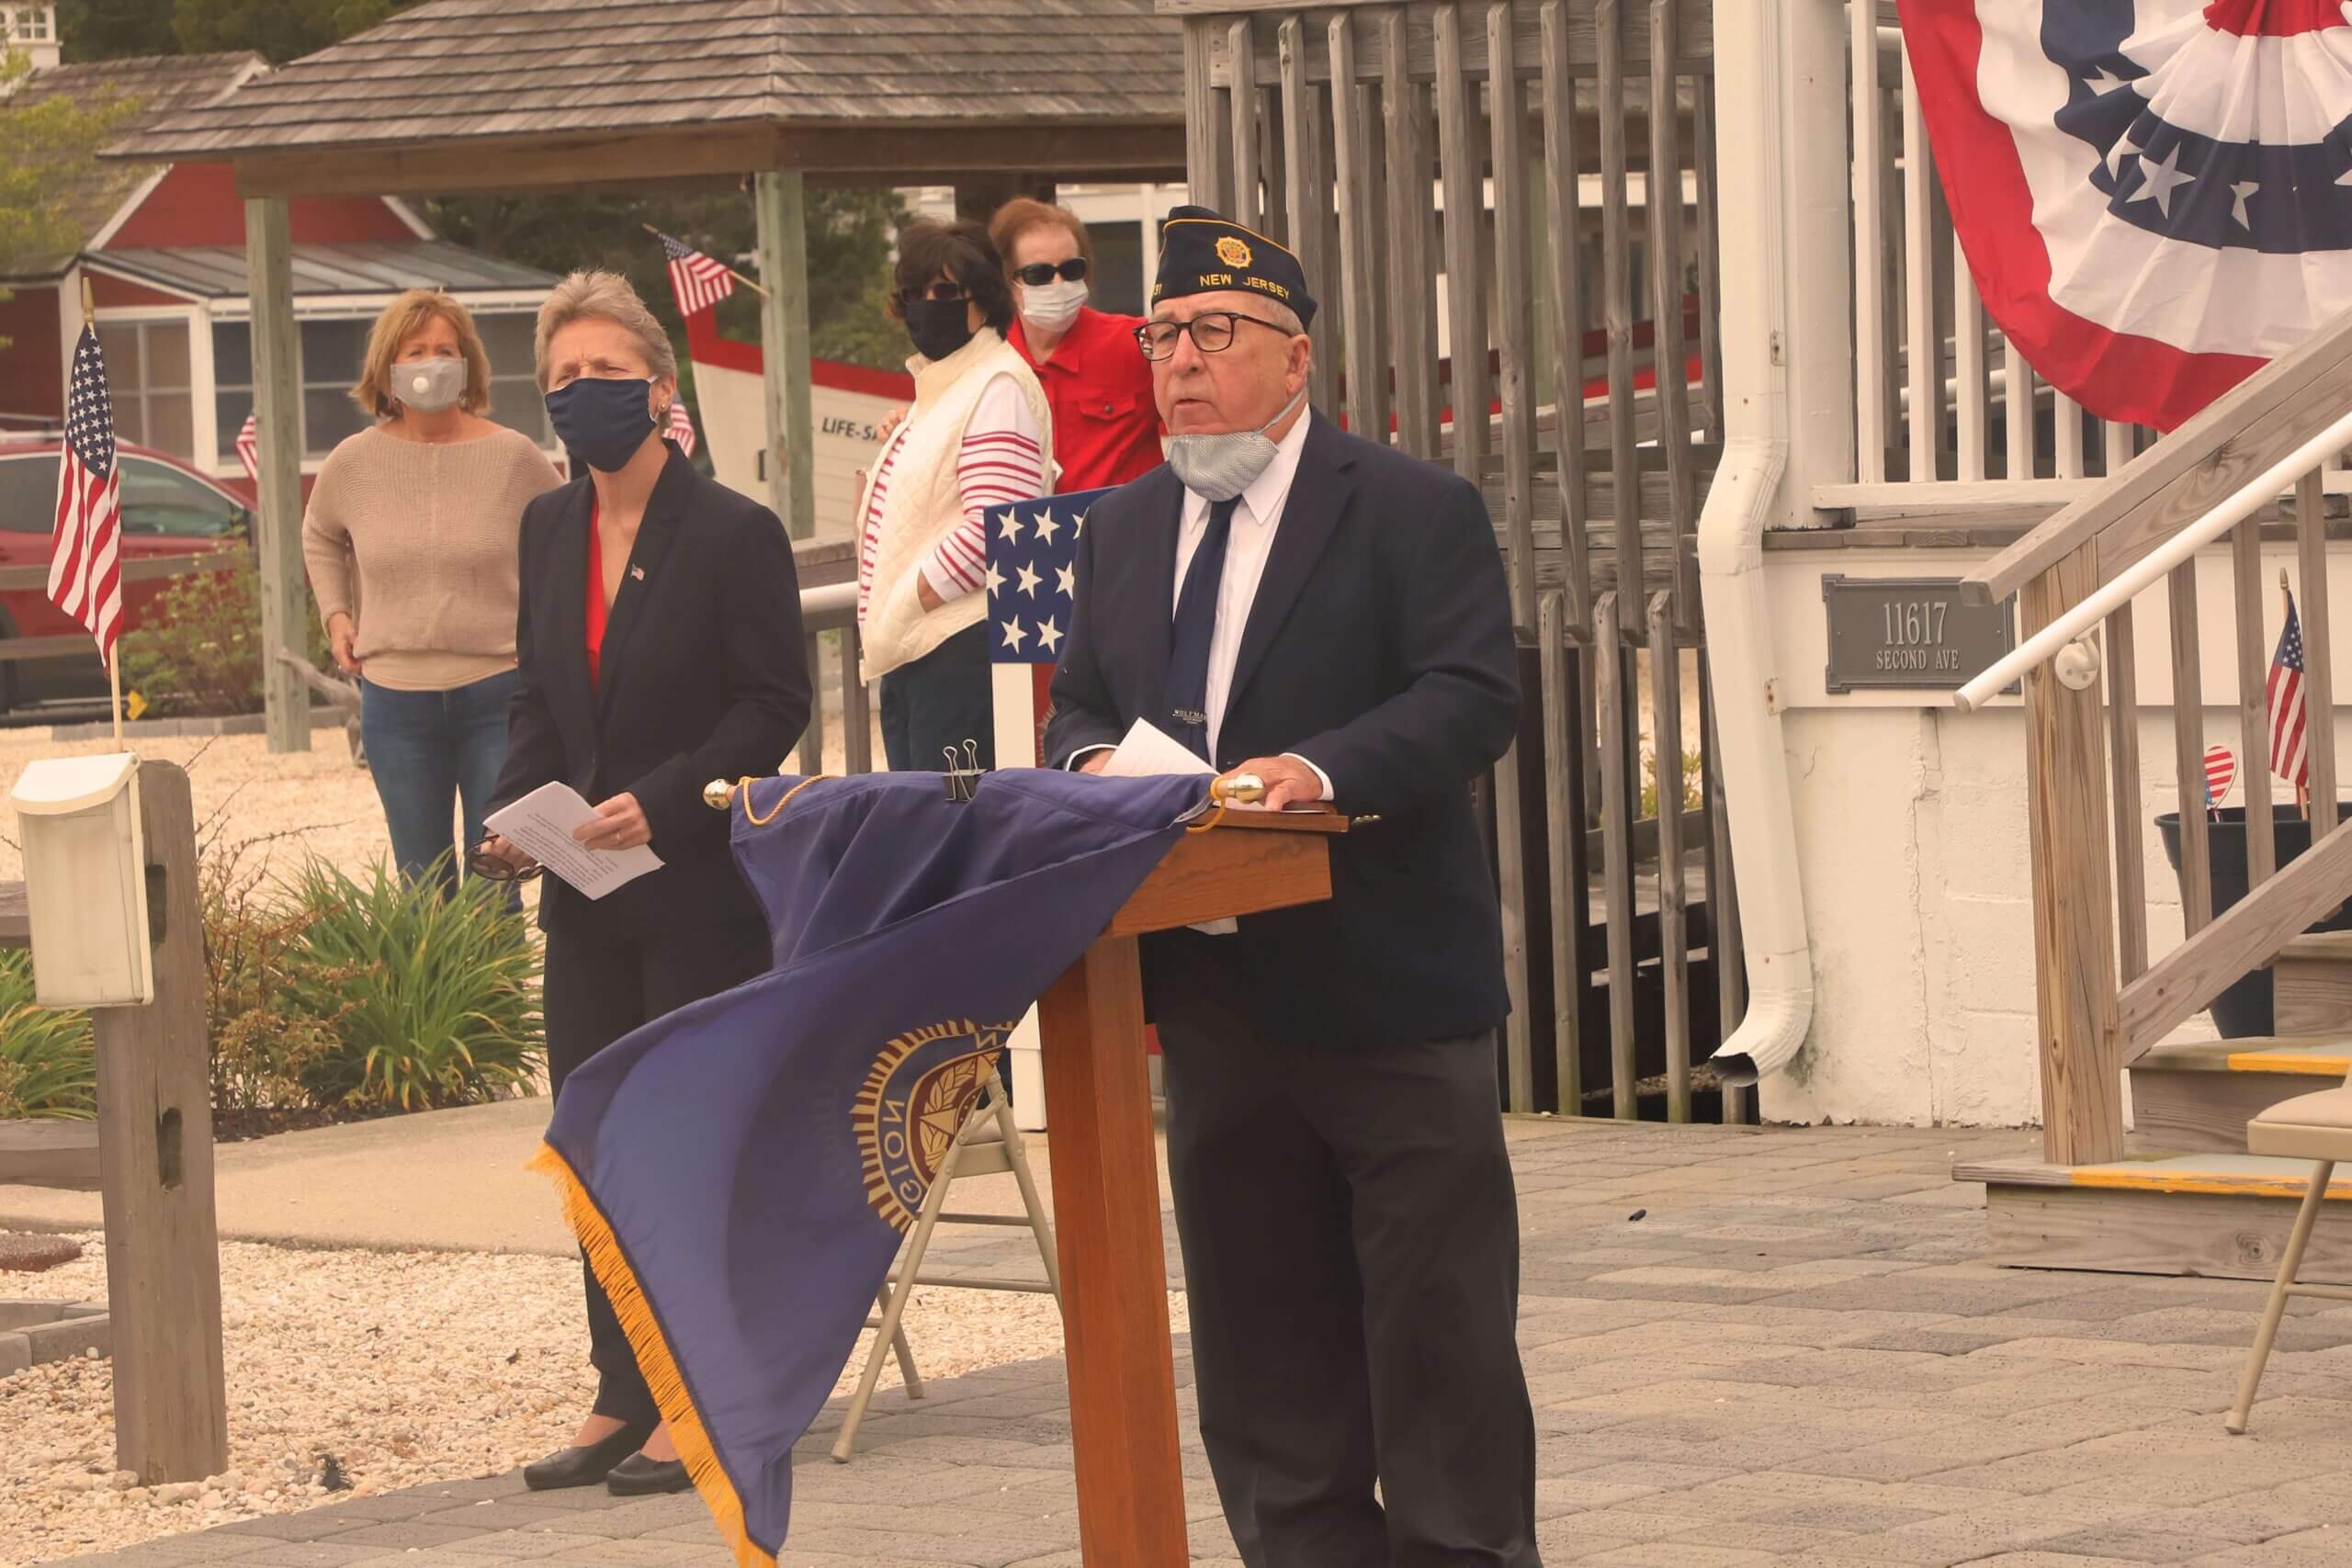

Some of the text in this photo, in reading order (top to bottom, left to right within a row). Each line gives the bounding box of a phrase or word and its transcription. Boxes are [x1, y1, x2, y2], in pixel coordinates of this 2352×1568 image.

[1199, 274, 1290, 299] NEW JERSEY
[1883, 602, 1948, 645] 11617
[1876, 649, 1960, 670] SECOND AVE
